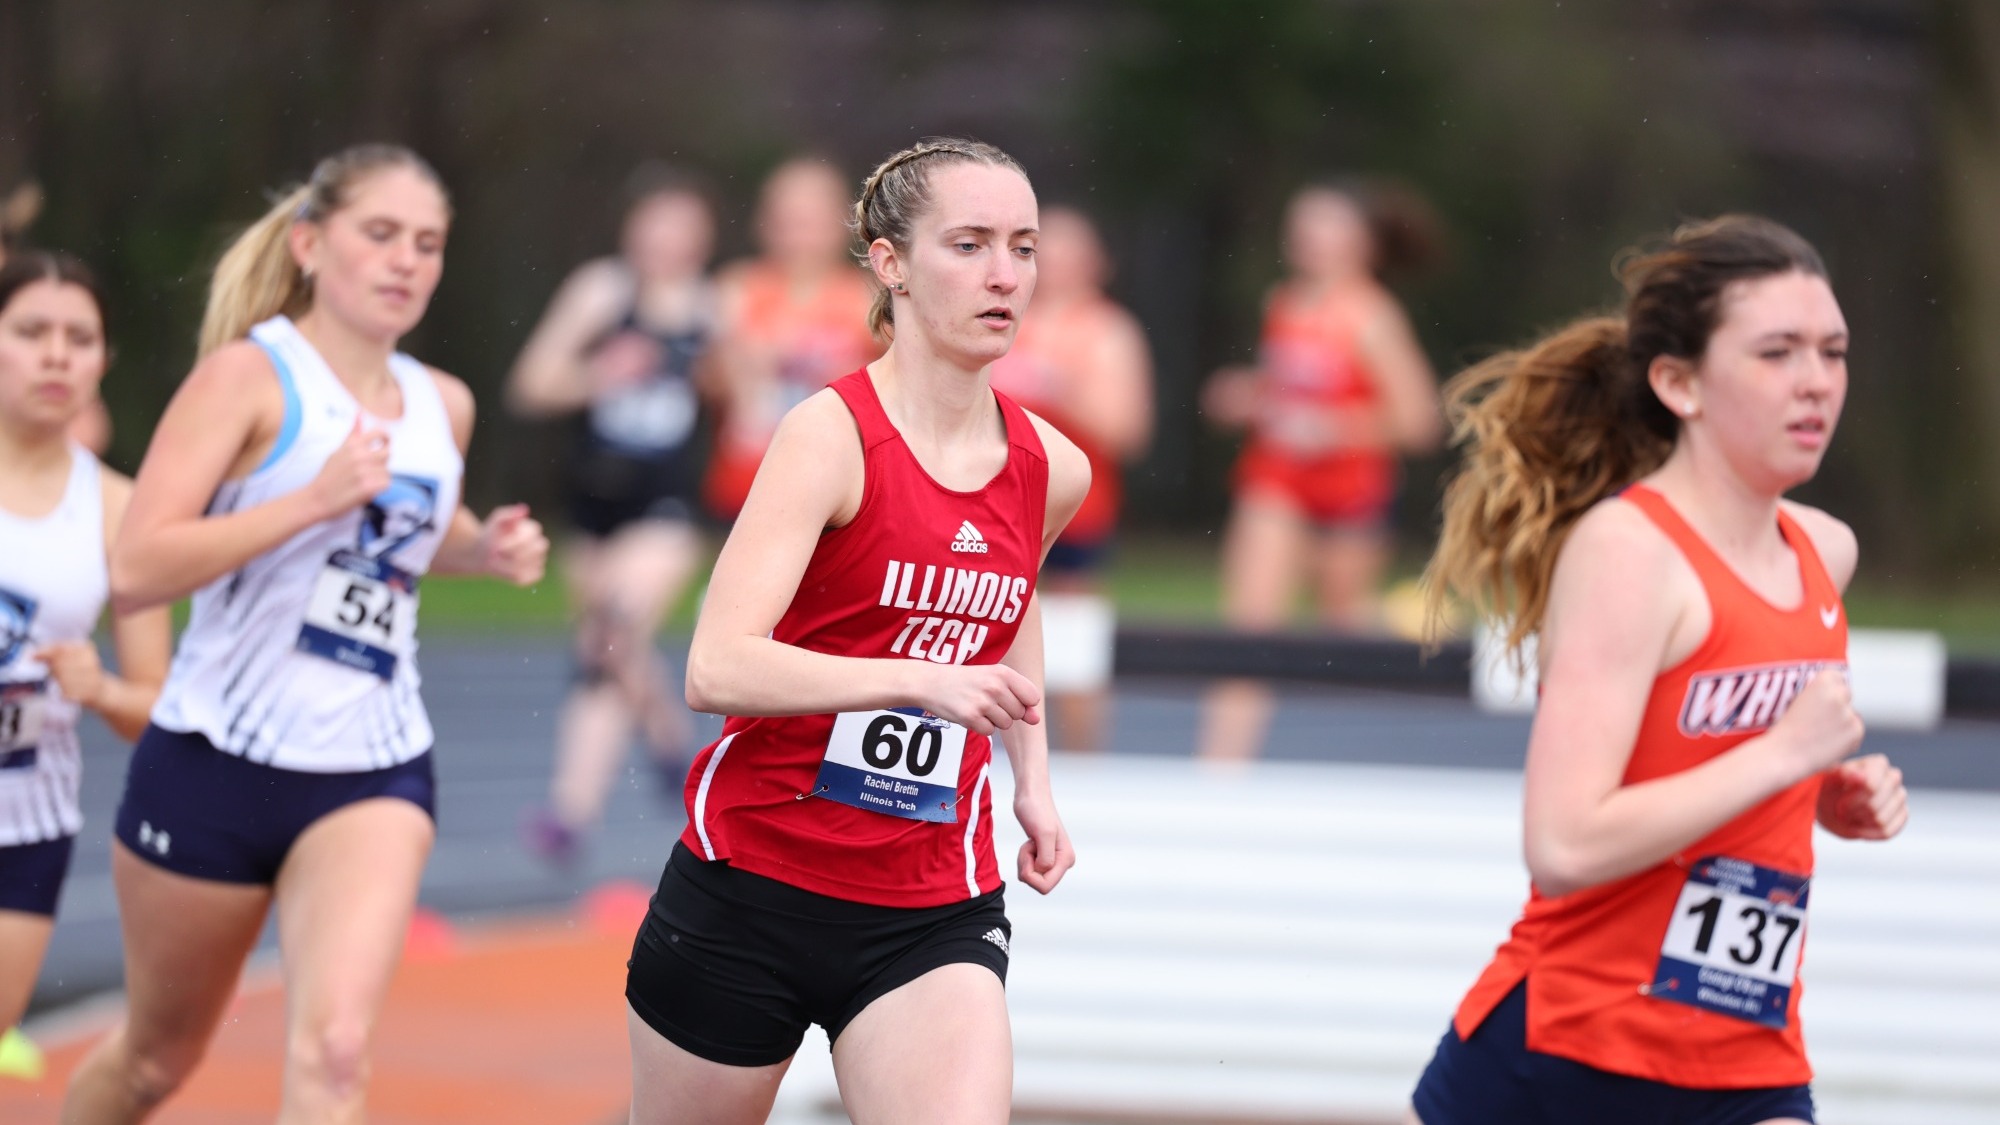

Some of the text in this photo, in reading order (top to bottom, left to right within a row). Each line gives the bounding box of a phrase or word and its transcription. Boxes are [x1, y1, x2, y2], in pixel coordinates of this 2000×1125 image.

[951, 539, 988, 554] adidas
[336, 583, 396, 639] 54
[879, 559, 1028, 625] ILLINOIS
[890, 616, 989, 665] TECH
[861, 714, 943, 777] 60
[860, 792, 917, 811] Illinois Tech
[864, 775, 919, 796] Rachel Brettin
[1687, 896, 1800, 974] 137
